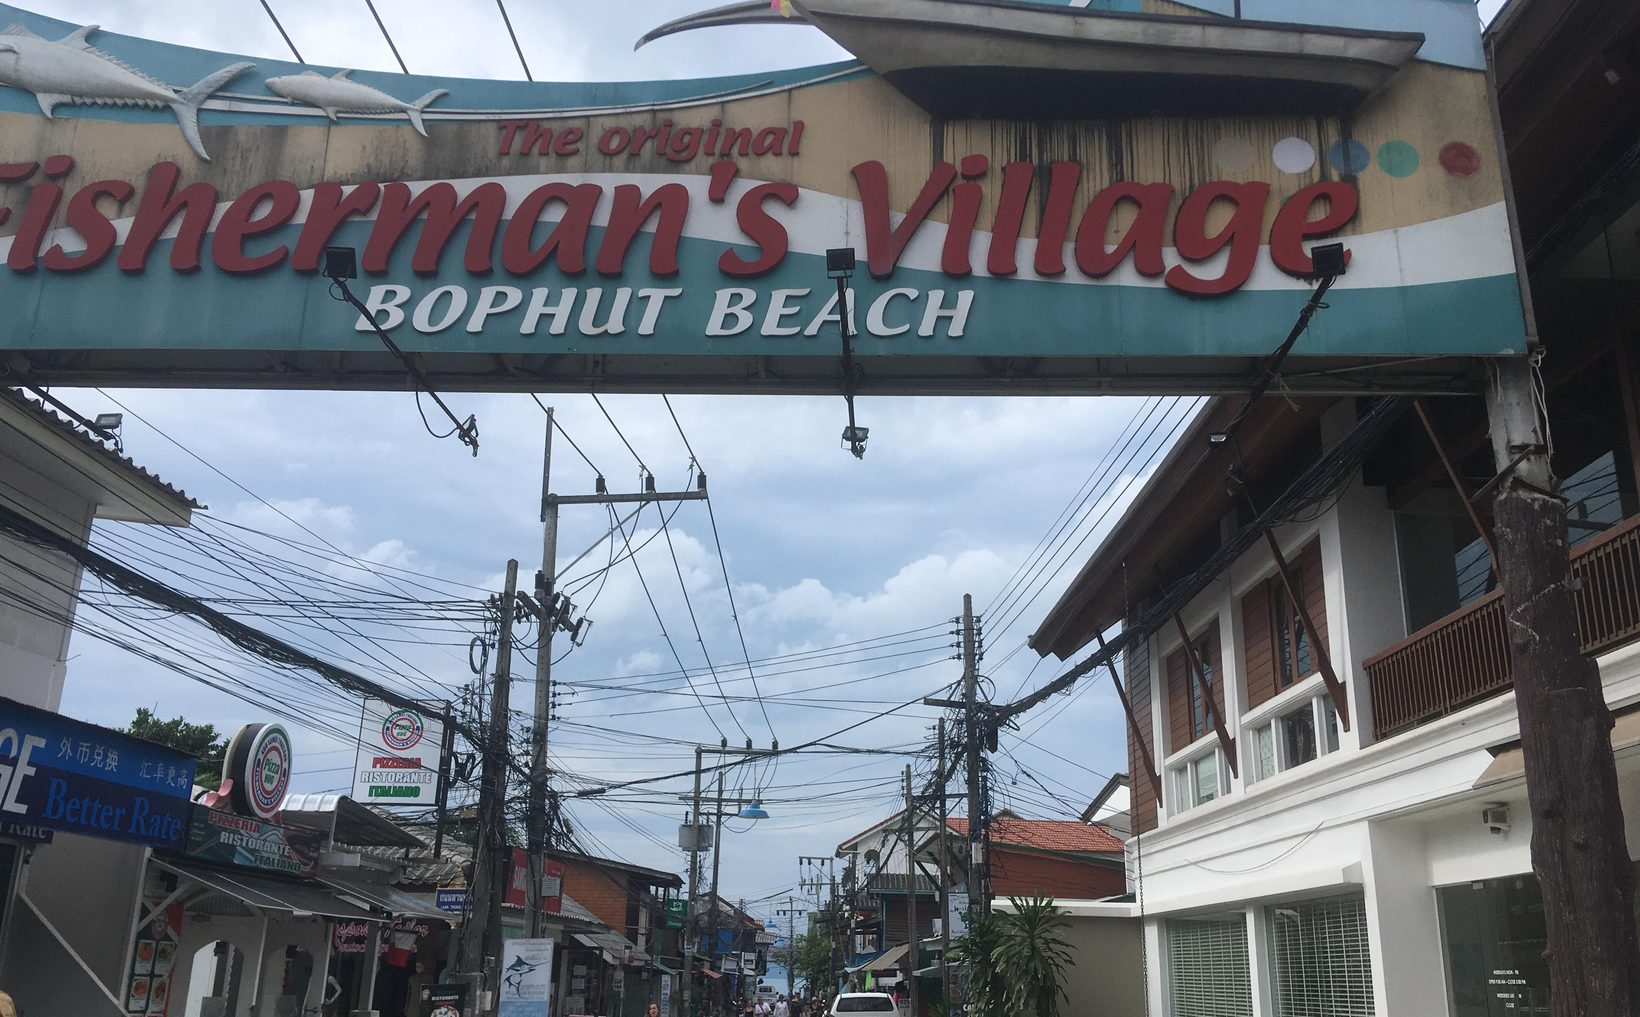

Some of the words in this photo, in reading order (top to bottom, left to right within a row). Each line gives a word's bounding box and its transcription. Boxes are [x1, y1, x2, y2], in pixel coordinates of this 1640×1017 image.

[499, 120, 583, 156] The
[599, 119, 804, 162] original
[851, 154, 1359, 295] Village
[354, 284, 682, 336] BOPHUT
[705, 287, 974, 337] BEACH
[57, 735, 119, 773] 外币兑换
[139, 760, 188, 790] 汇率更高
[360, 771, 432, 784] RISTORANTE
[42, 776, 126, 831] Better
[128, 795, 182, 841] Rate
[368, 785, 421, 798] ITALIANO
[208, 810, 261, 833] PIZZERIA
[220, 831, 291, 856] RISTORANTE
[253, 853, 301, 873] ITALIANO
